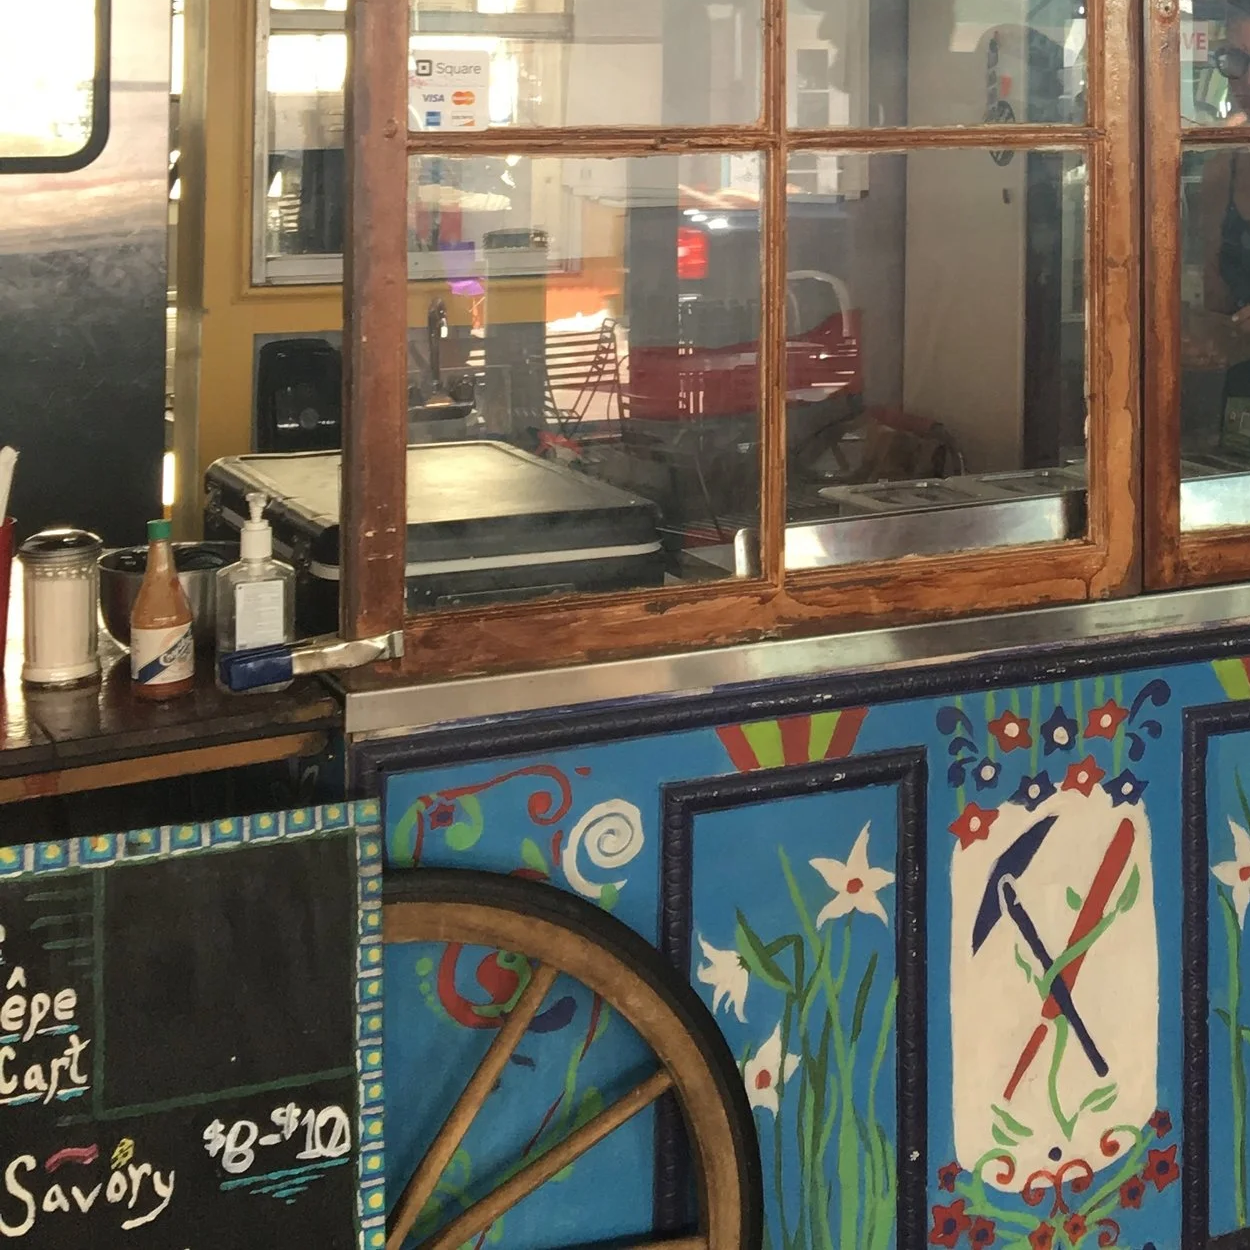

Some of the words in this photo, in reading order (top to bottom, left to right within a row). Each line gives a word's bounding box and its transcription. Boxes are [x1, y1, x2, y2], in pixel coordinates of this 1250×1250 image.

[436, 62, 482, 76] Square
[422, 94, 445, 102] VISA
[0, 1154, 176, 1238] Savory
